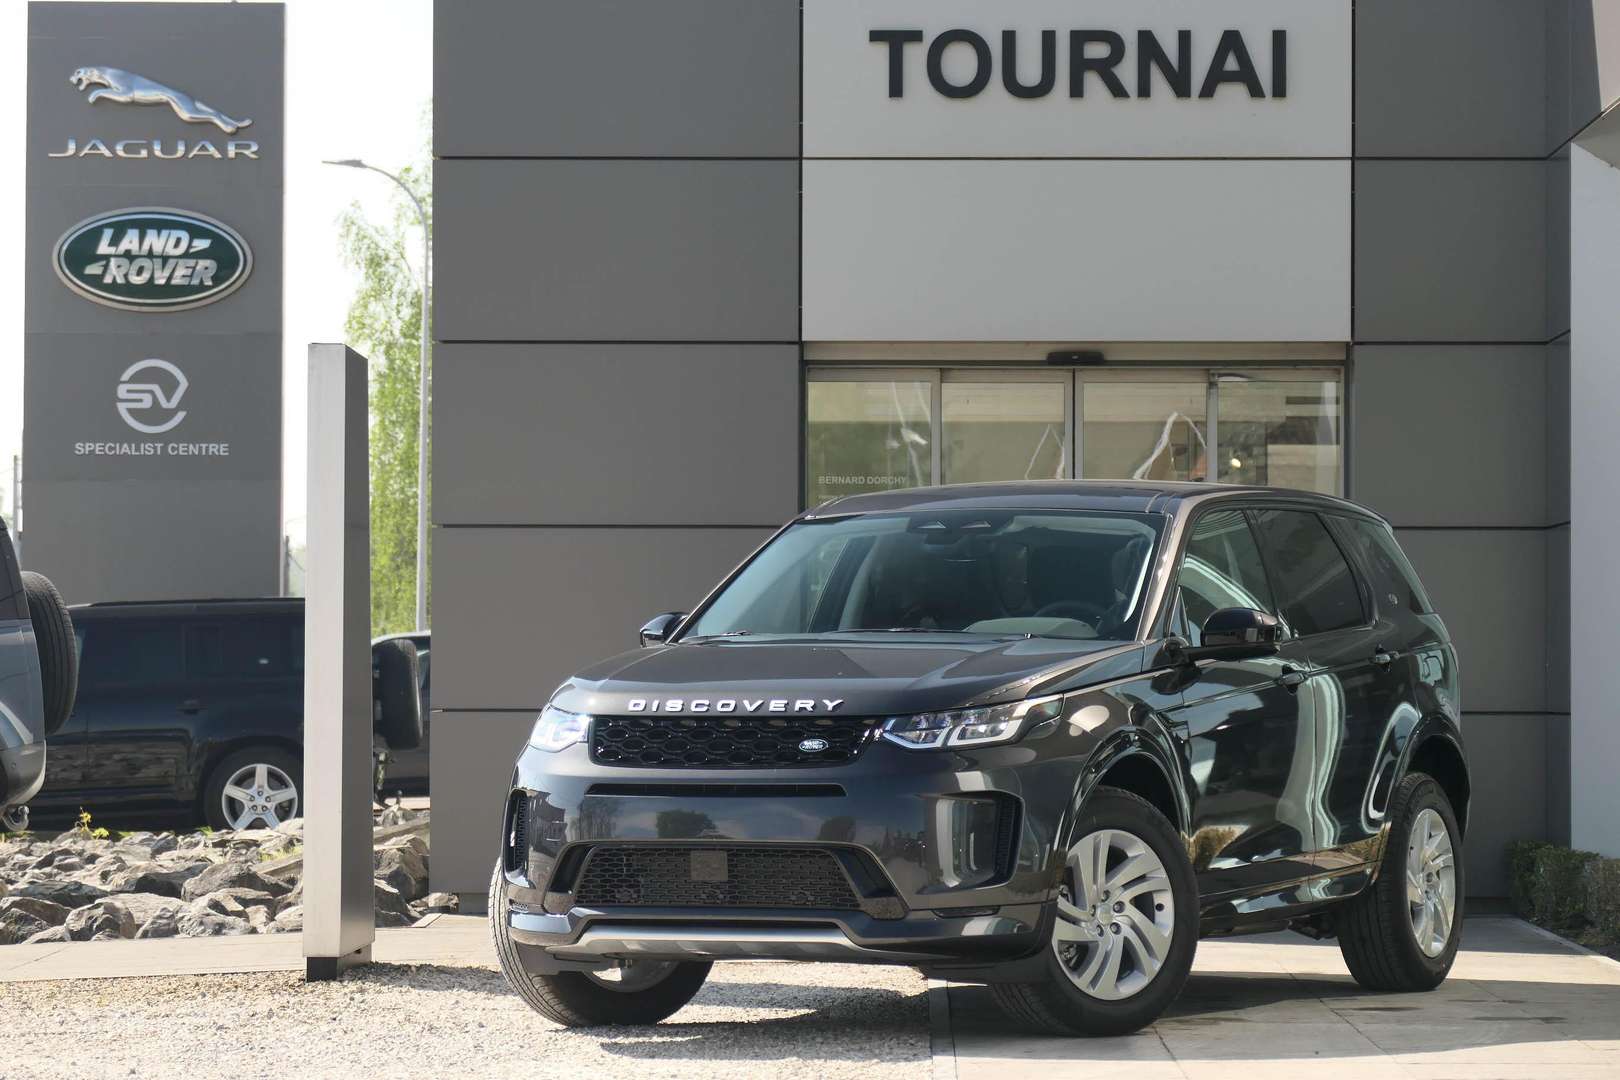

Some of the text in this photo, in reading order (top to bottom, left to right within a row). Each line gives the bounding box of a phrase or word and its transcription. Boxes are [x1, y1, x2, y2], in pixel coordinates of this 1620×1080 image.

[869, 29, 1287, 98] TOURNAI
[48, 139, 259, 159] JAGUAR
[96, 228, 191, 256] LAND
[103, 257, 218, 286] ROVER
[74, 442, 229, 456] SPECIALIST CENTRE
[818, 475, 865, 485] BERNARD
[628, 699, 844, 712] DISCOVERY
